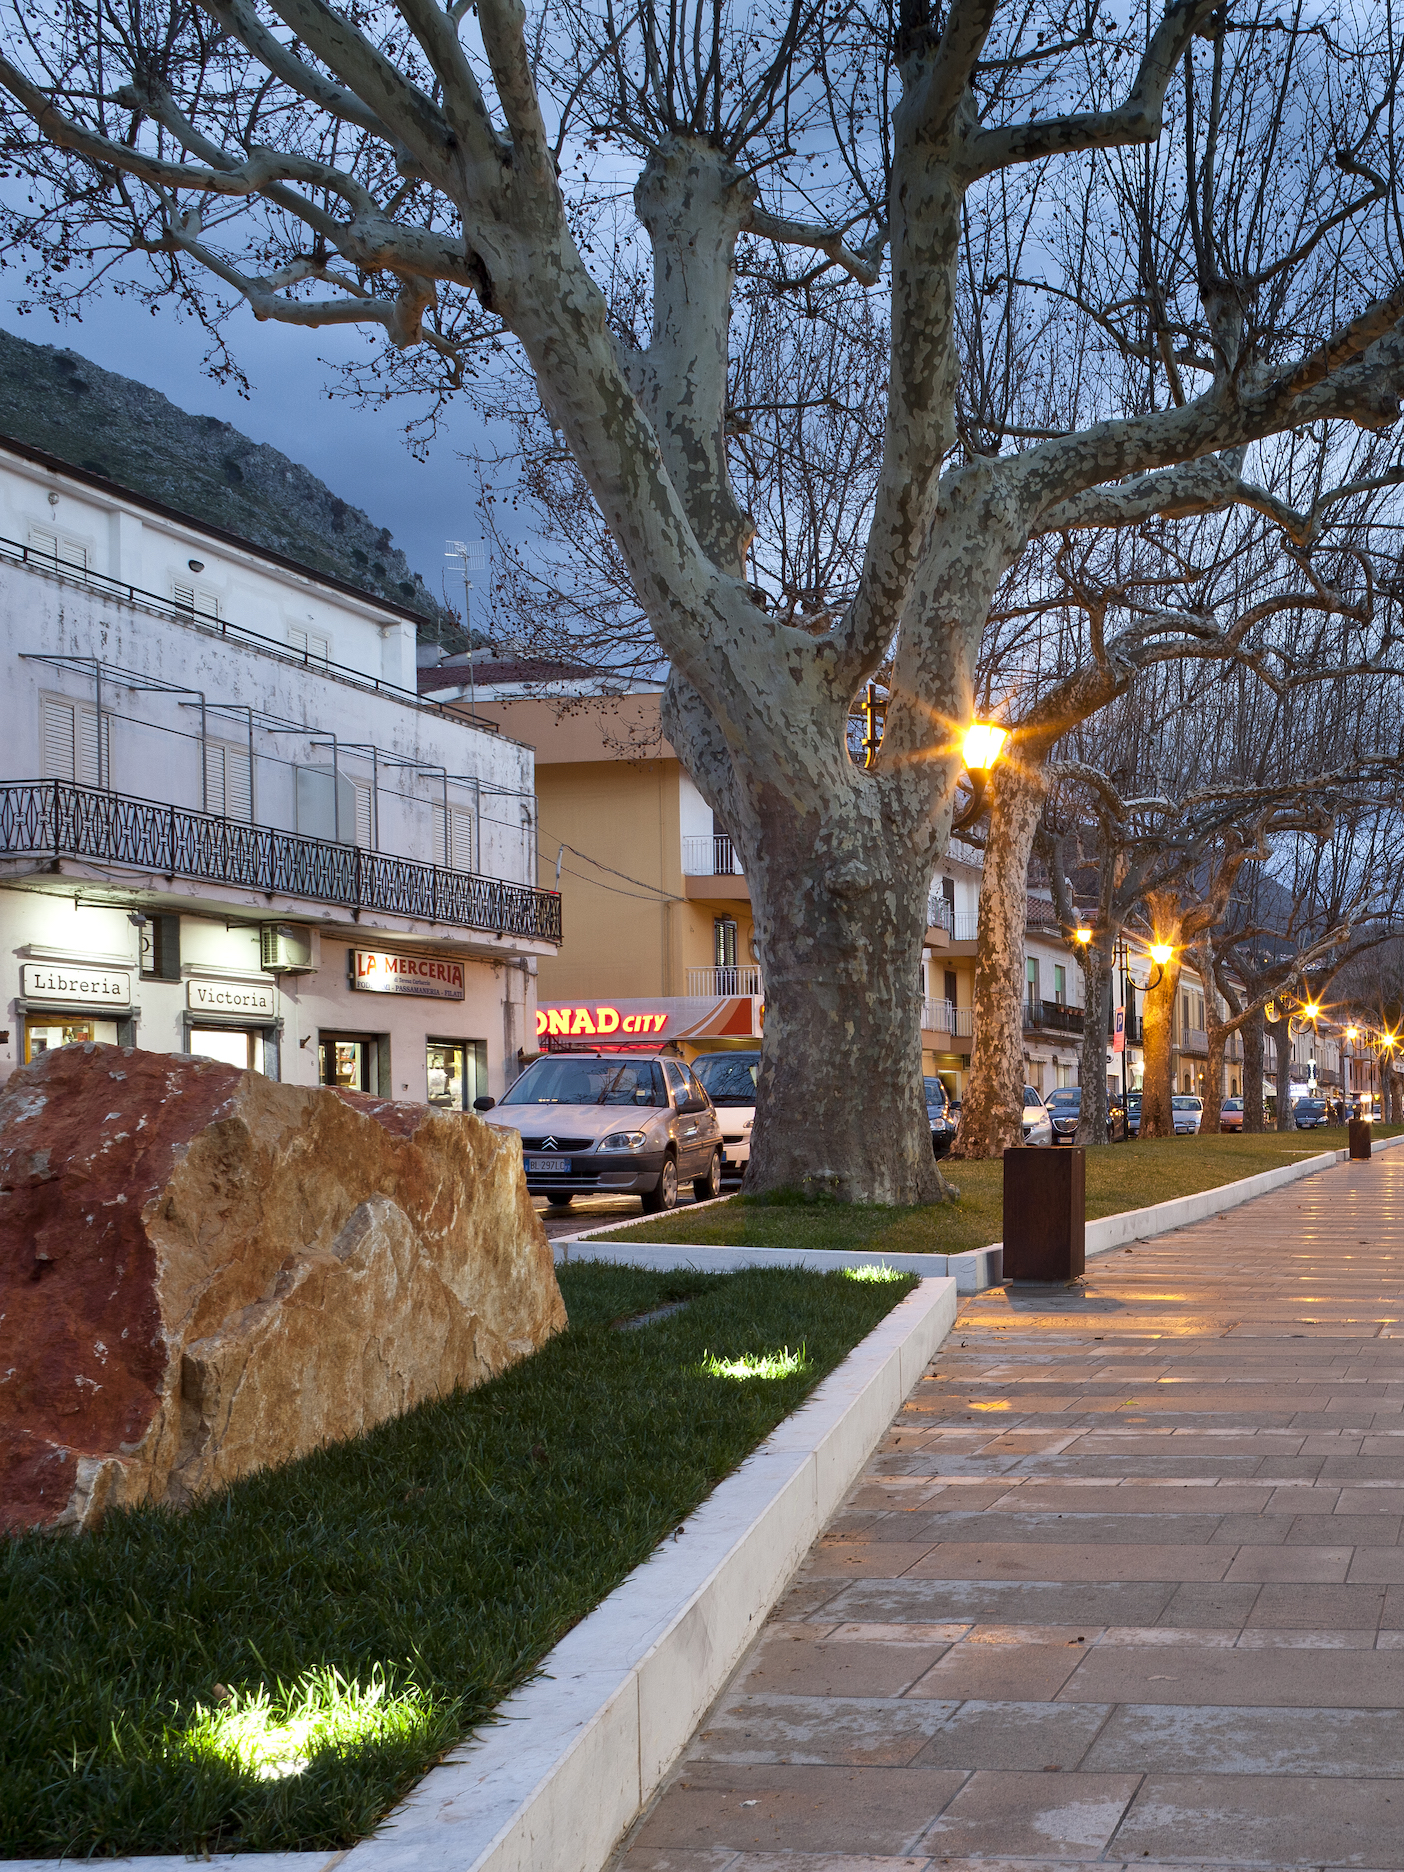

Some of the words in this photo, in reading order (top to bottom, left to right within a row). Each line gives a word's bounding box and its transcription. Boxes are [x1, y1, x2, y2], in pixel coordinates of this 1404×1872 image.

[357, 954, 377, 977] LA
[385, 957, 463, 988] MERCERIA
[34, 974, 121, 995] Libreria
[395, 985, 440, 996] PASSAMANERIA
[444, 989, 463, 998] FILATI
[197, 988, 267, 1008] Victoria
[622, 1014, 667, 1033] CITY
[530, 1161, 540, 1170] BL
